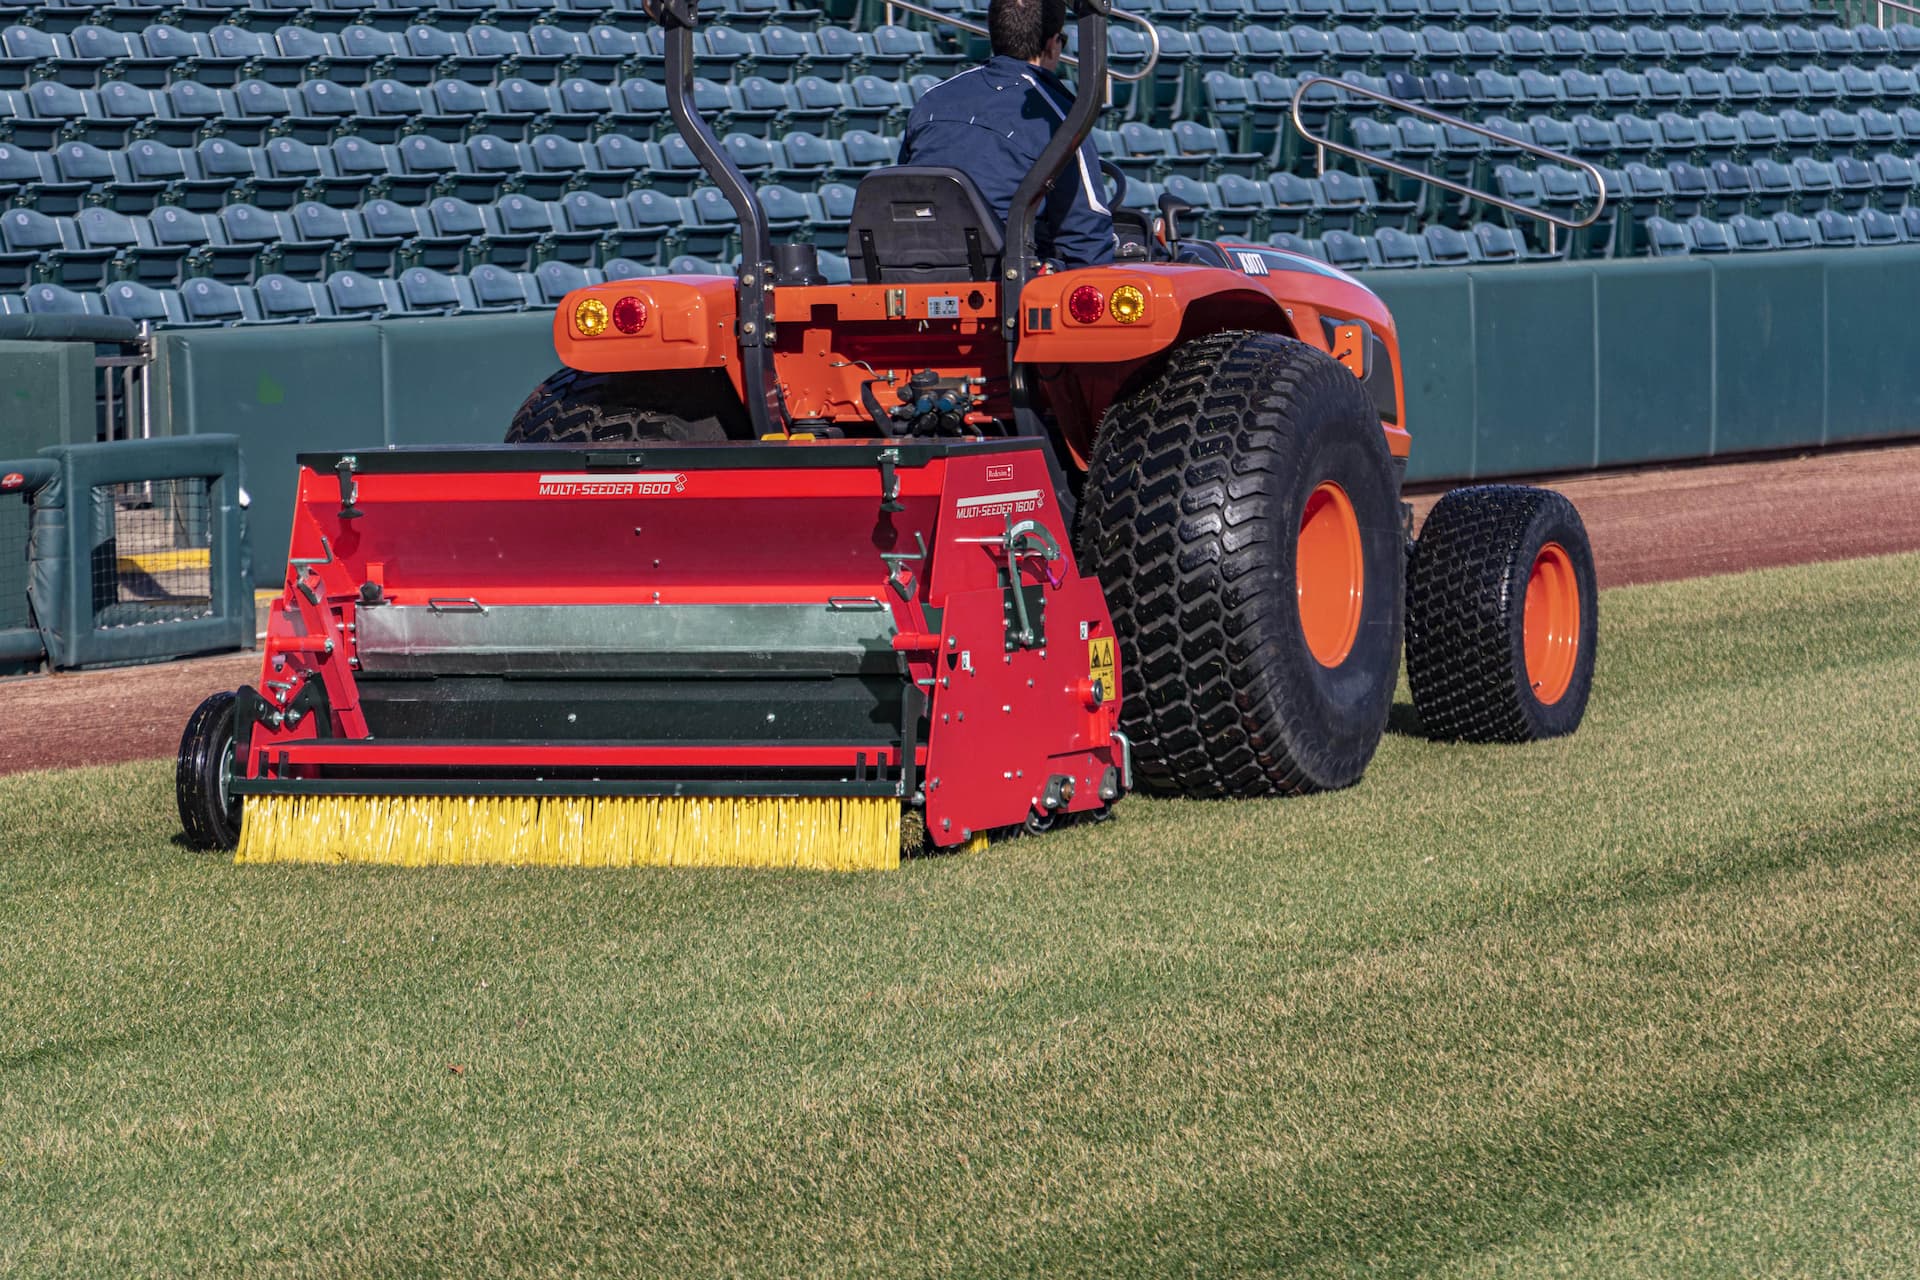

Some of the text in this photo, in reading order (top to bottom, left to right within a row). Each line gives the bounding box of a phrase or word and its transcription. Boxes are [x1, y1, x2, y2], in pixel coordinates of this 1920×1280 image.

[539, 483, 671, 495] MULTI-SEEDER 1600
[956, 500, 1035, 519] MULTI-SEEDER 1600
